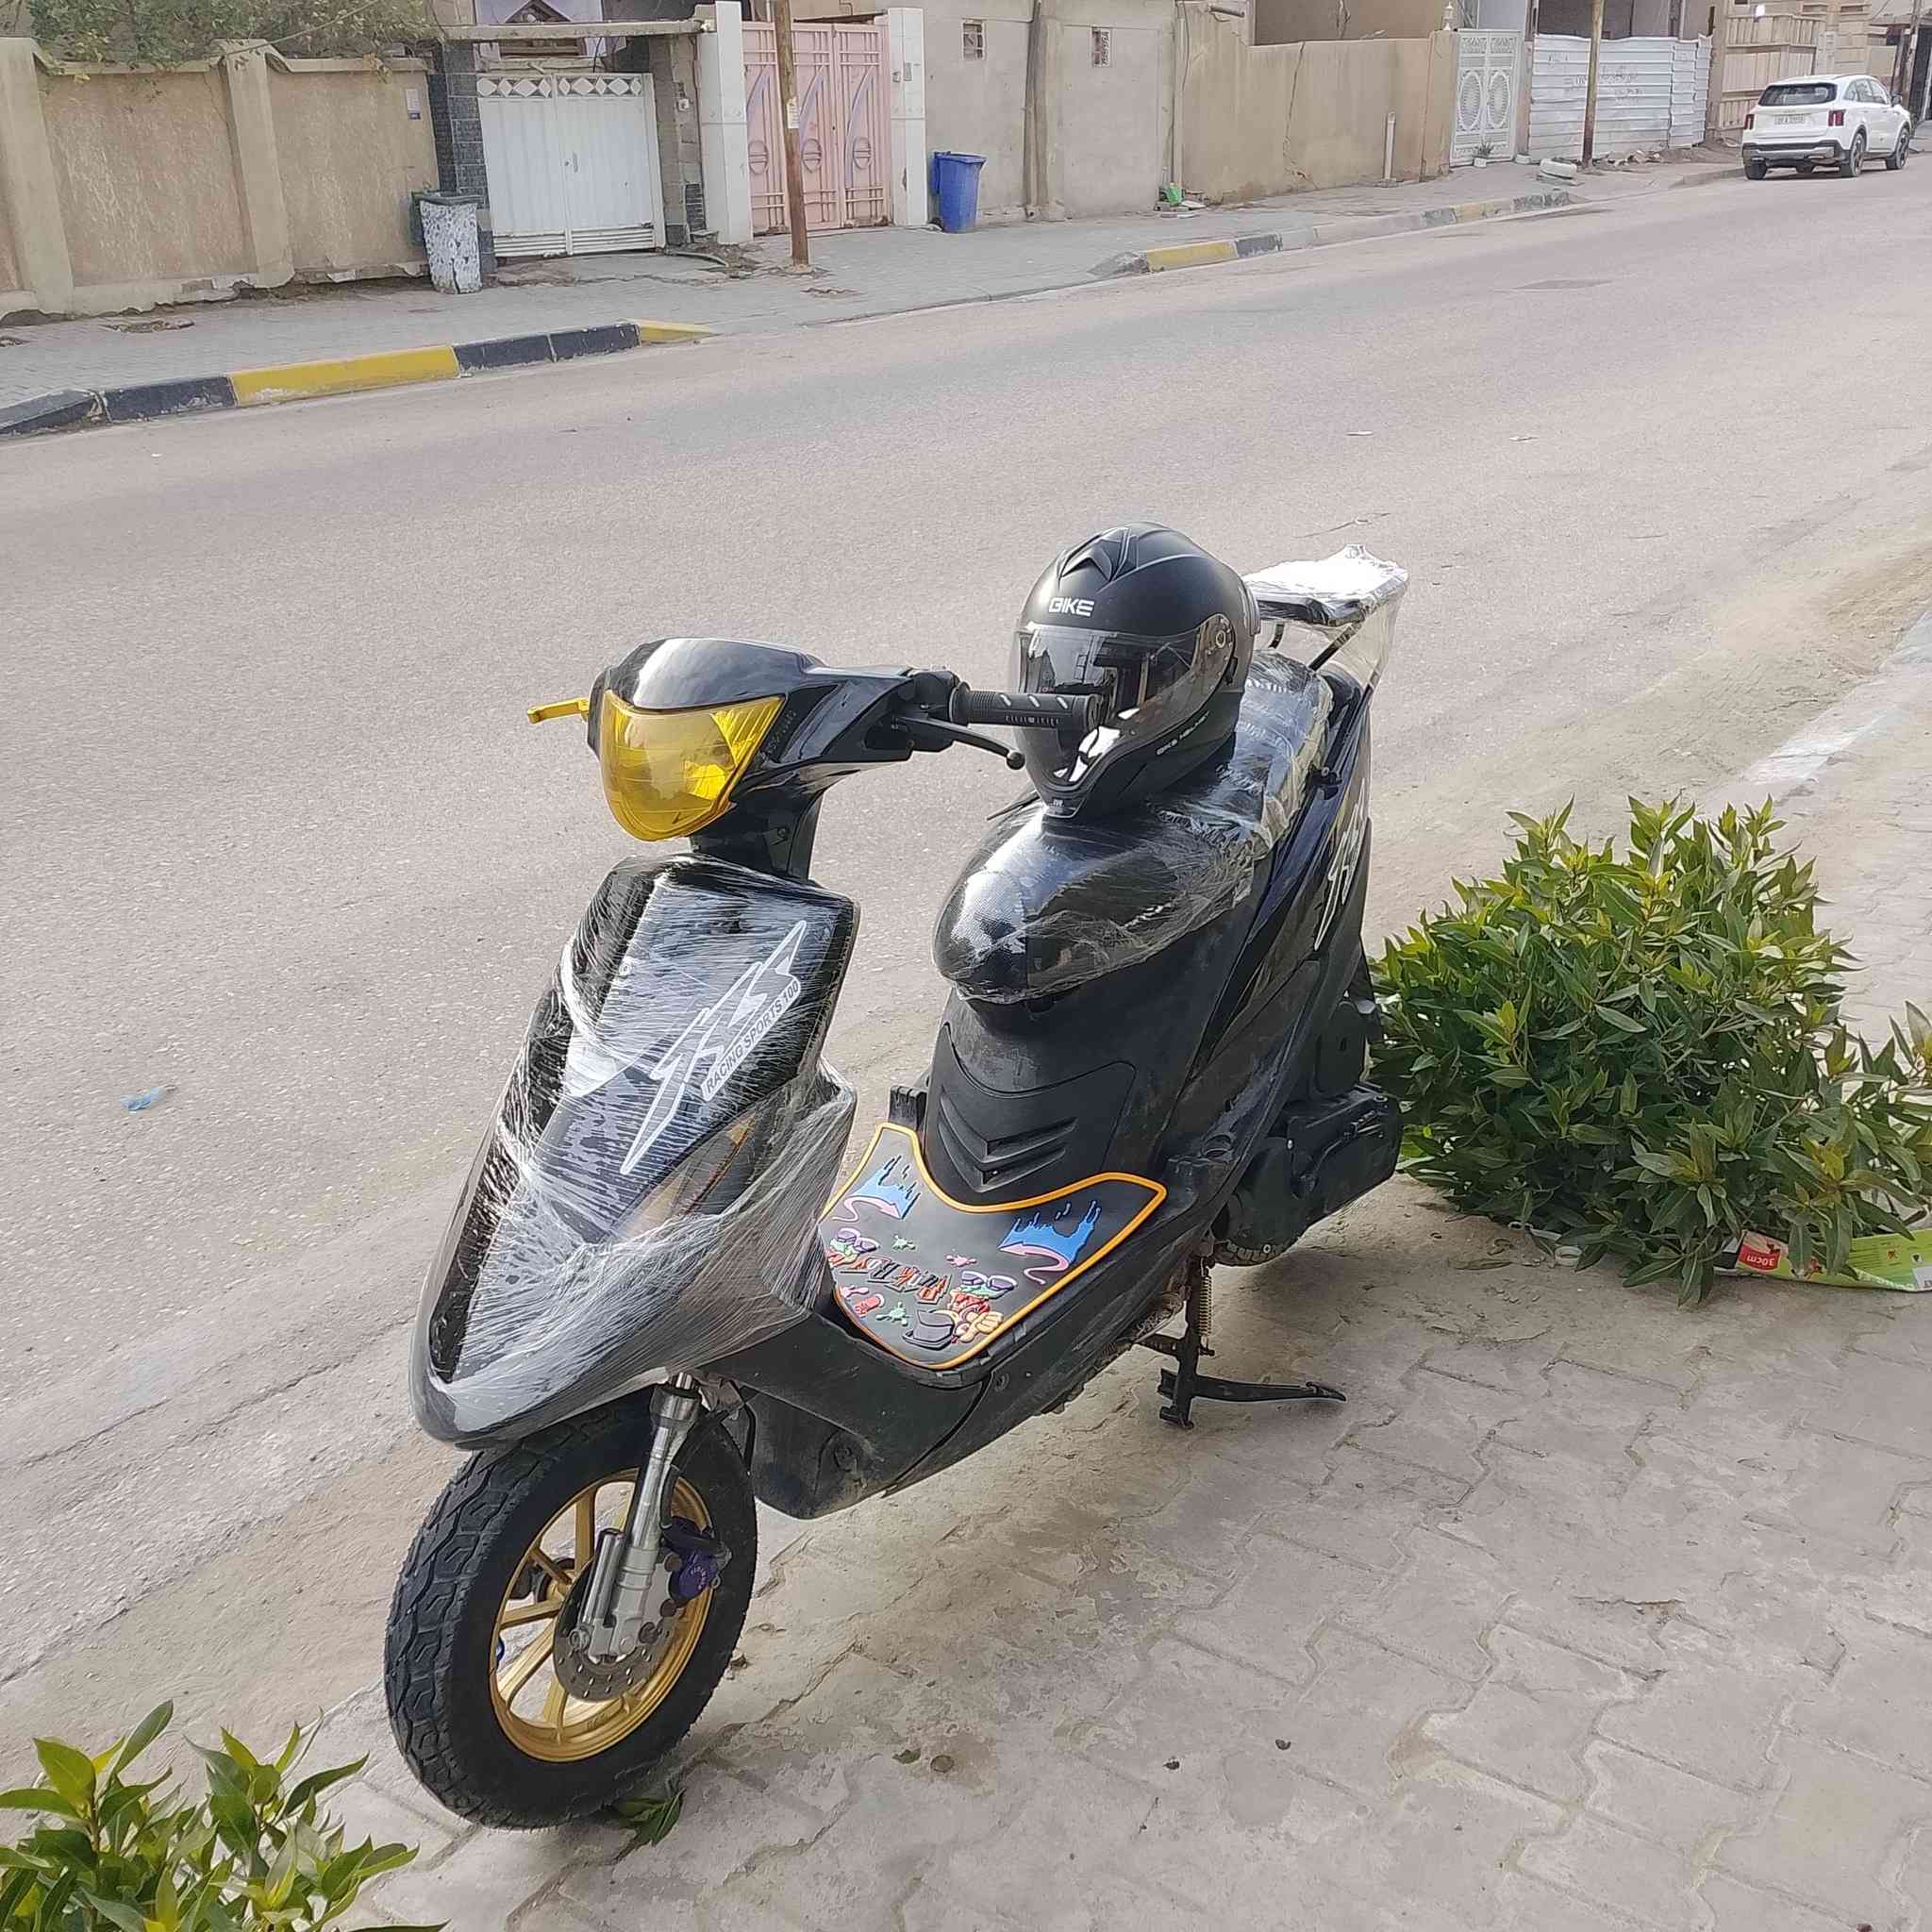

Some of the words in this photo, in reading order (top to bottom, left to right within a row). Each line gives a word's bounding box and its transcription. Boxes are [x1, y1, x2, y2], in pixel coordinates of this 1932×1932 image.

[706, 1044, 743, 1093] RACING
[743, 998, 782, 1049] SPORTS
[782, 979, 799, 1004] 100
[1746, 1255, 1775, 1266] 30cm
